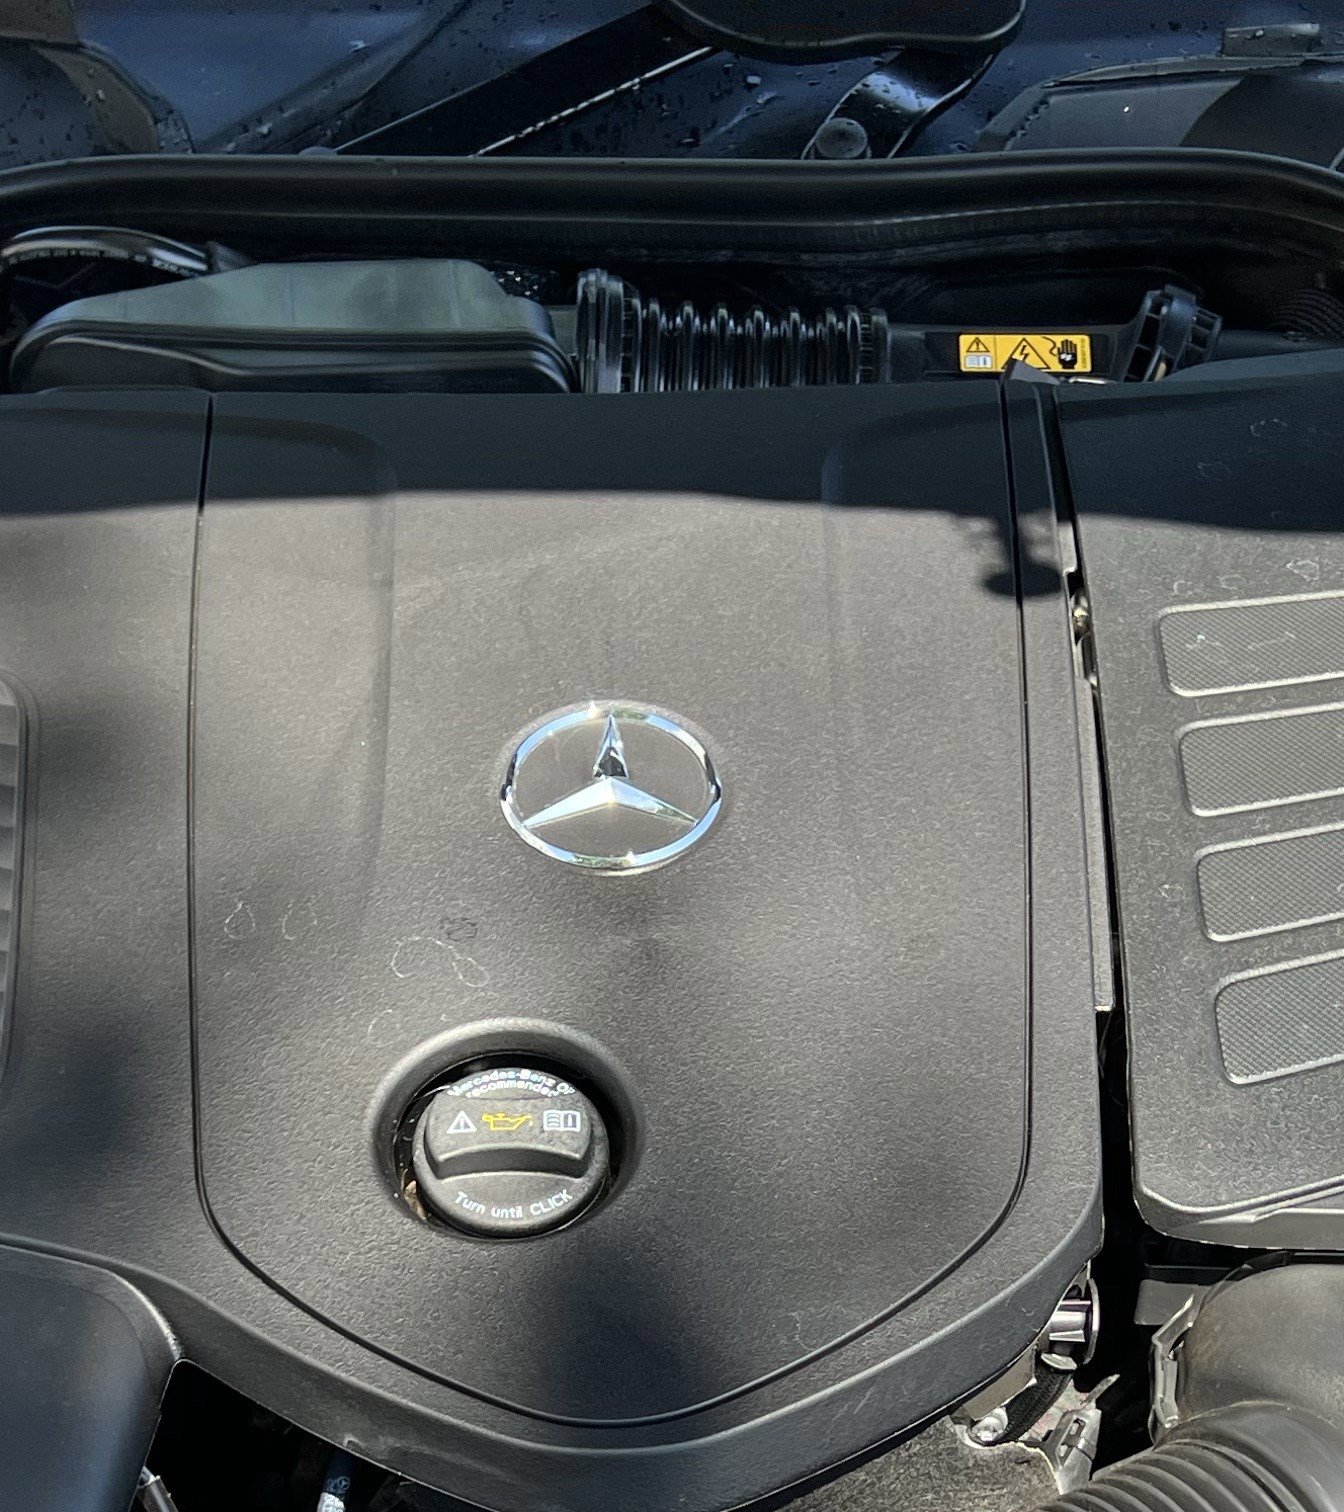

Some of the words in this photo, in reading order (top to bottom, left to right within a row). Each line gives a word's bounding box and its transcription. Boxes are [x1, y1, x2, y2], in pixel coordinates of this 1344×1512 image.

[454, 1190, 486, 1216] Turn
[491, 1205, 523, 1219] until
[529, 1188, 574, 1217] CLICK
